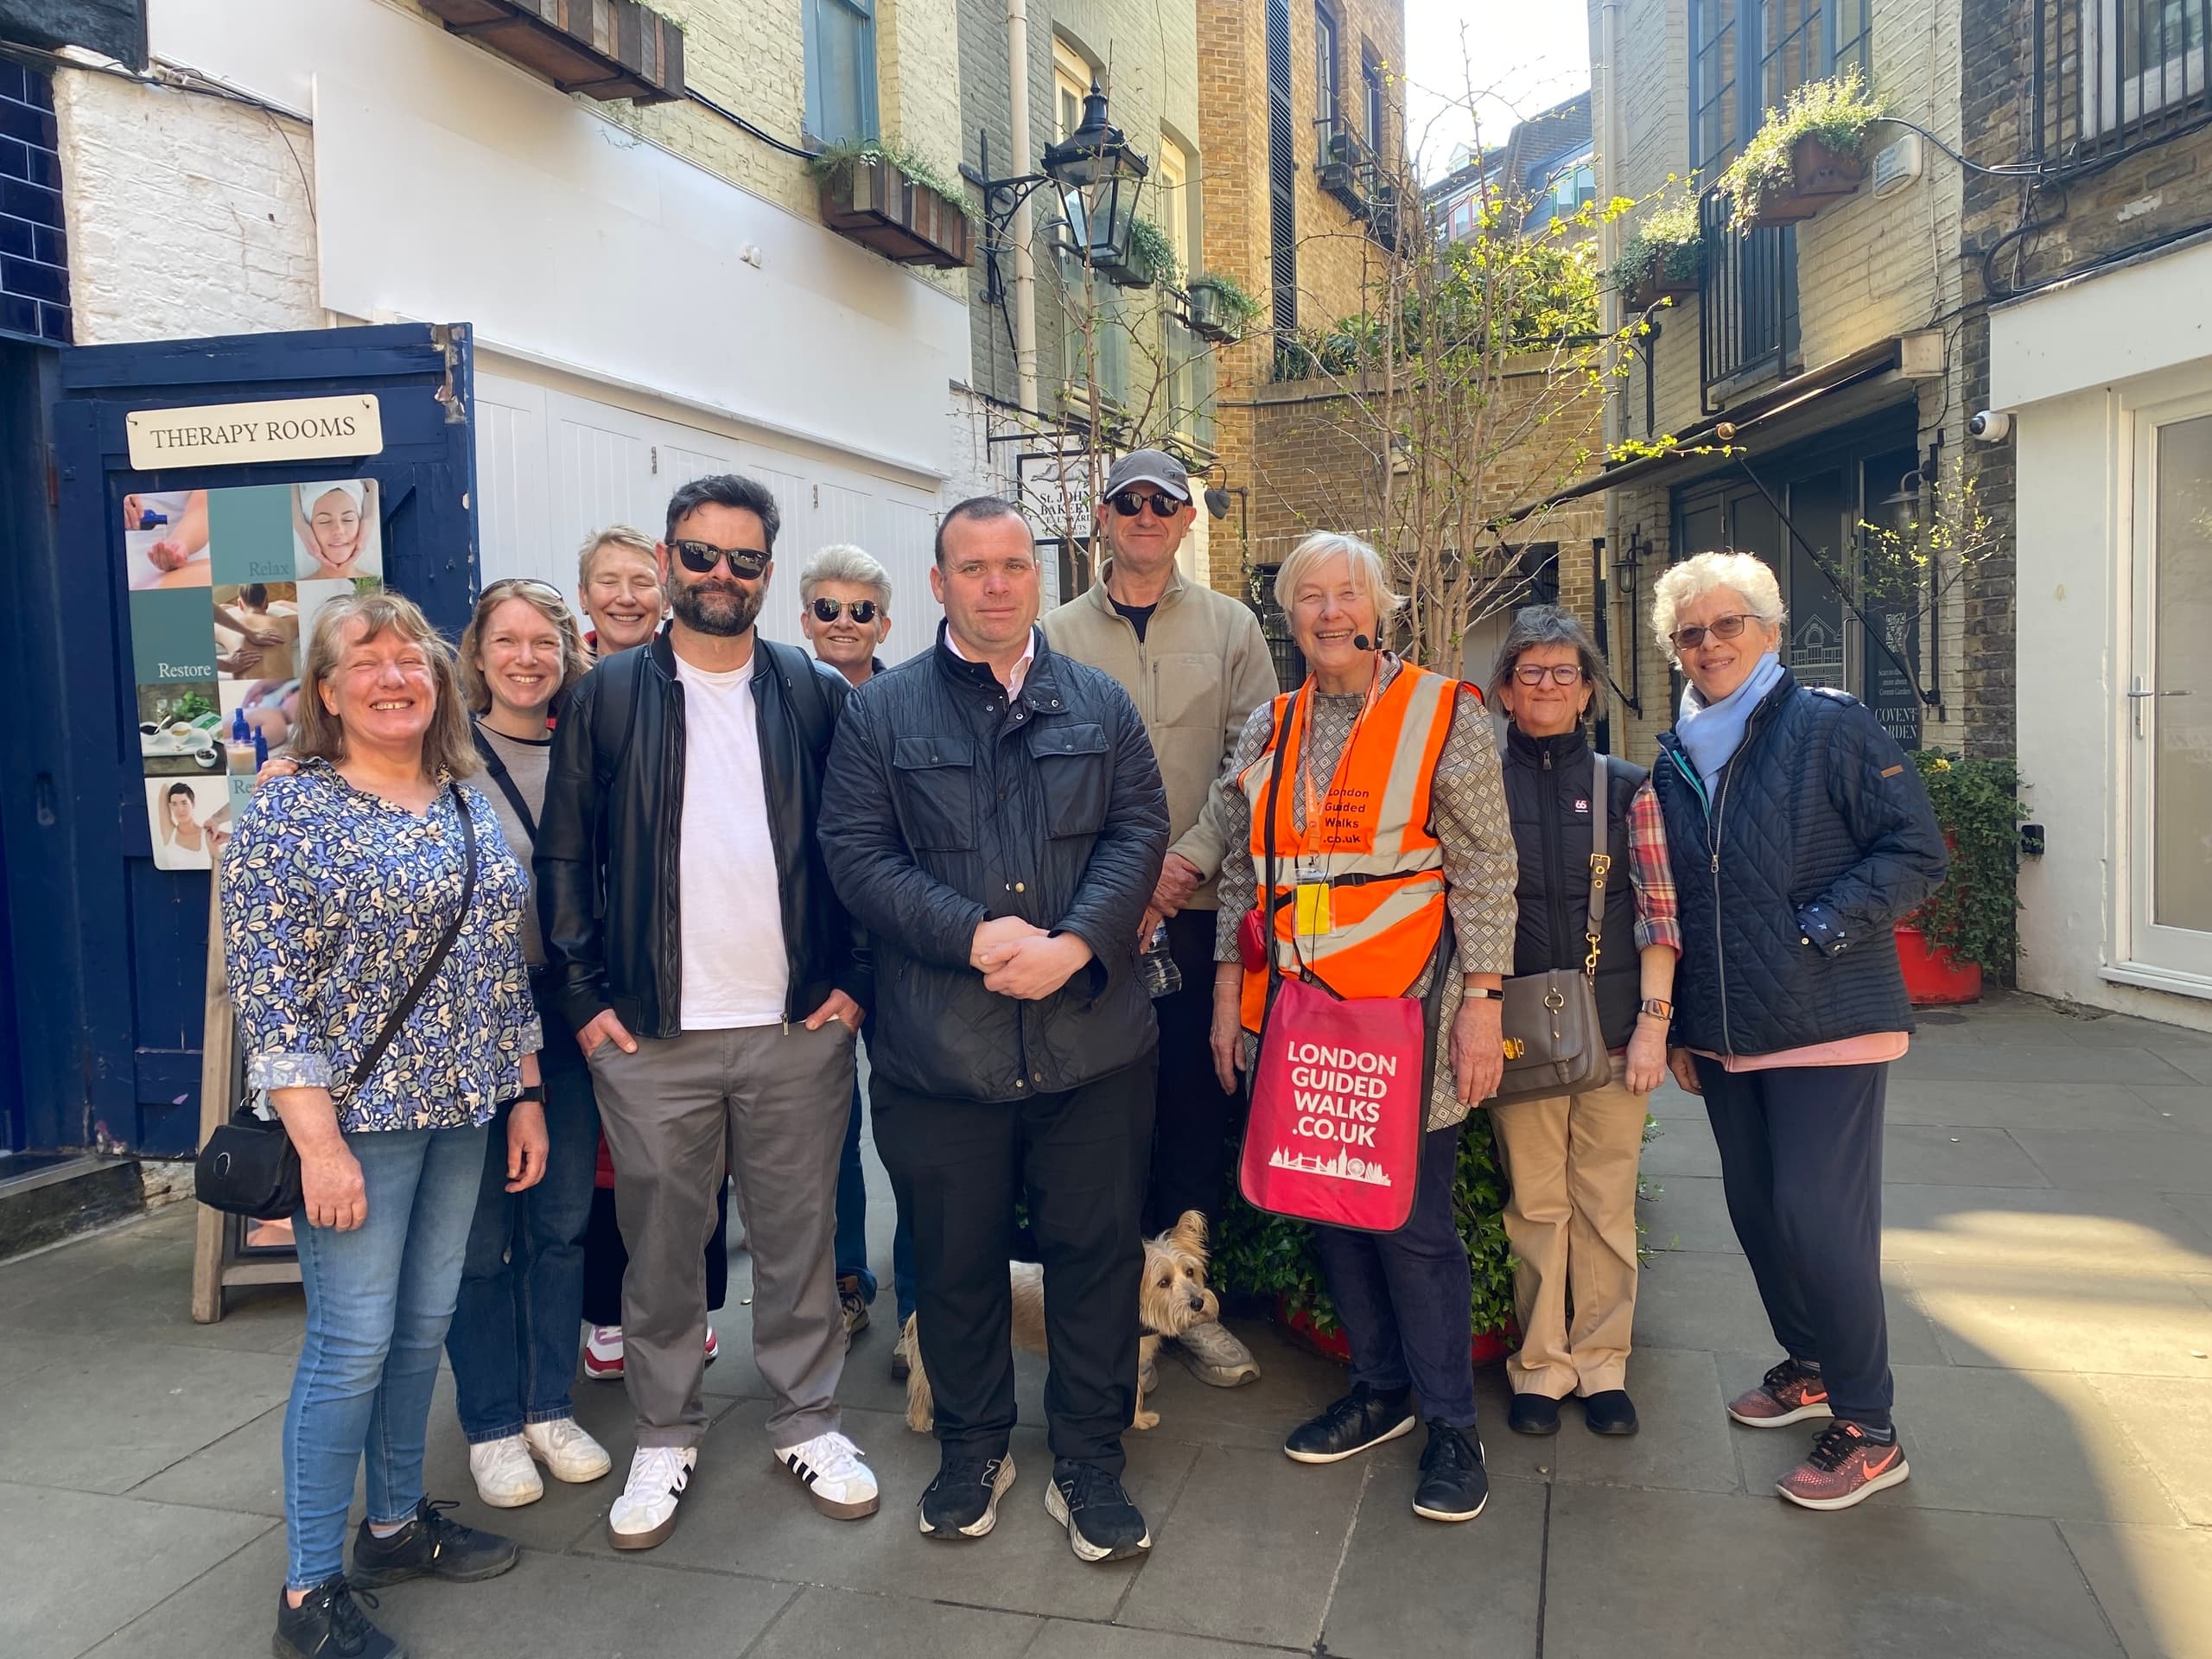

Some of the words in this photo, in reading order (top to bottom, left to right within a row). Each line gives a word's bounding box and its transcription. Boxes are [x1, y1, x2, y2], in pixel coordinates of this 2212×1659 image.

[149, 423, 258, 448] THERAPY
[265, 416, 356, 441] ROOMS
[1039, 493, 1054, 503] St.
[249, 561, 289, 577] Relax
[157, 662, 212, 678] Restore
[1875, 707, 1917, 722] COVENT
[1888, 724, 1917, 740] RDEN
[1328, 787, 1370, 798] London
[1325, 817, 1359, 829] Walks
[1323, 834, 1361, 843] .co.uk
[1287, 1040, 1396, 1077] LONDON
[1291, 1066, 1388, 1099] GUIDED
[1294, 1090, 1381, 1123] WALKS
[1292, 1116, 1376, 1148] .CO.UK
